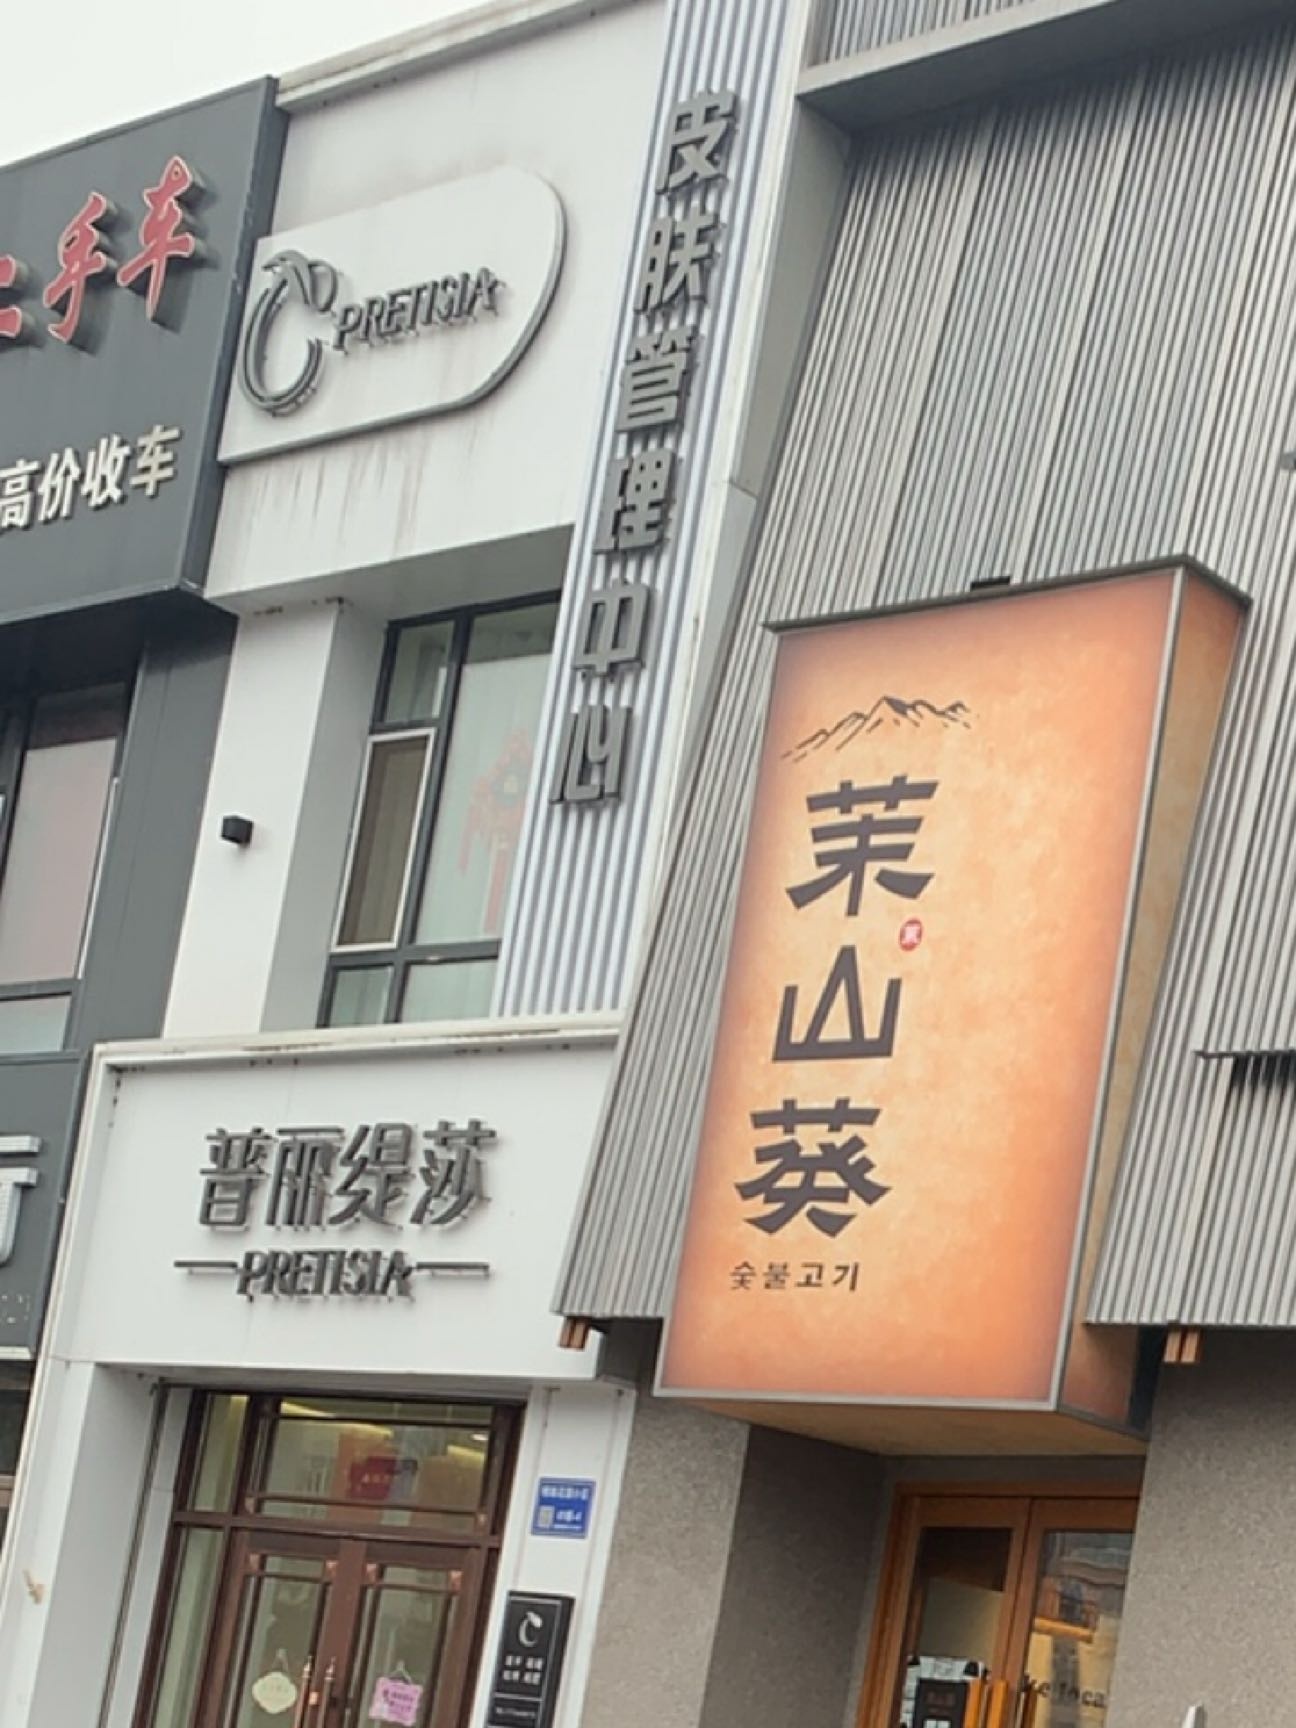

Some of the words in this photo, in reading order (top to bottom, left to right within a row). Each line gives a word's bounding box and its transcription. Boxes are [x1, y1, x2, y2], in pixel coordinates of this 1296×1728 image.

[332, 265, 502, 352] PRETISIA
[0, 424, 181, 529] 高价收车
[549, 90, 737, 804] 皮肤管理中心
[735, 774, 939, 1238] 茉山葵
[199, 1118, 498, 1227] 普丽缇莎
[235, 1248, 415, 1298] PRETISIA
